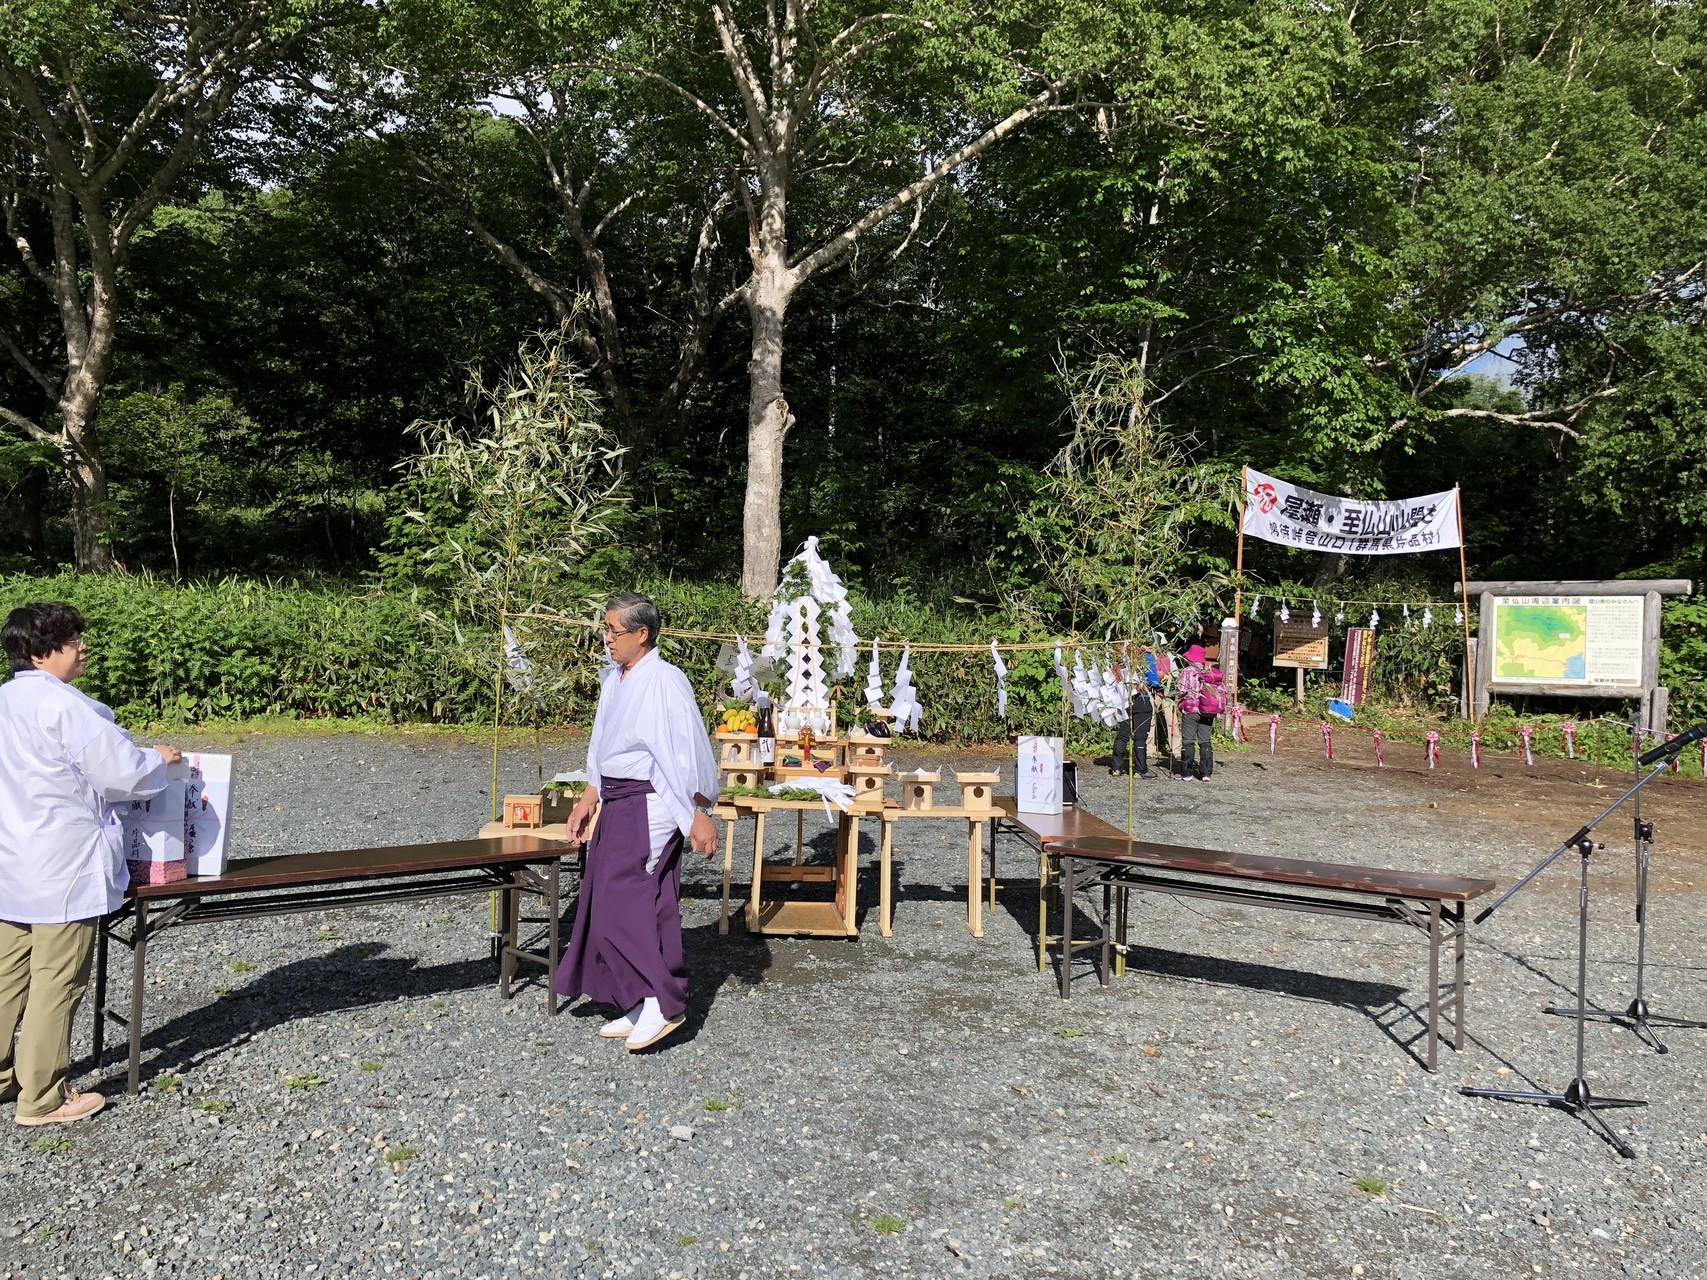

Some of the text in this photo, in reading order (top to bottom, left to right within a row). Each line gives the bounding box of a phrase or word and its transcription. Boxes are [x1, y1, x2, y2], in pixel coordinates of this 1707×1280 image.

[1280, 495, 1437, 537] 尾瀬・至仏山山開き
[1502, 597, 1582, 605] 至仏山周辺案内図
